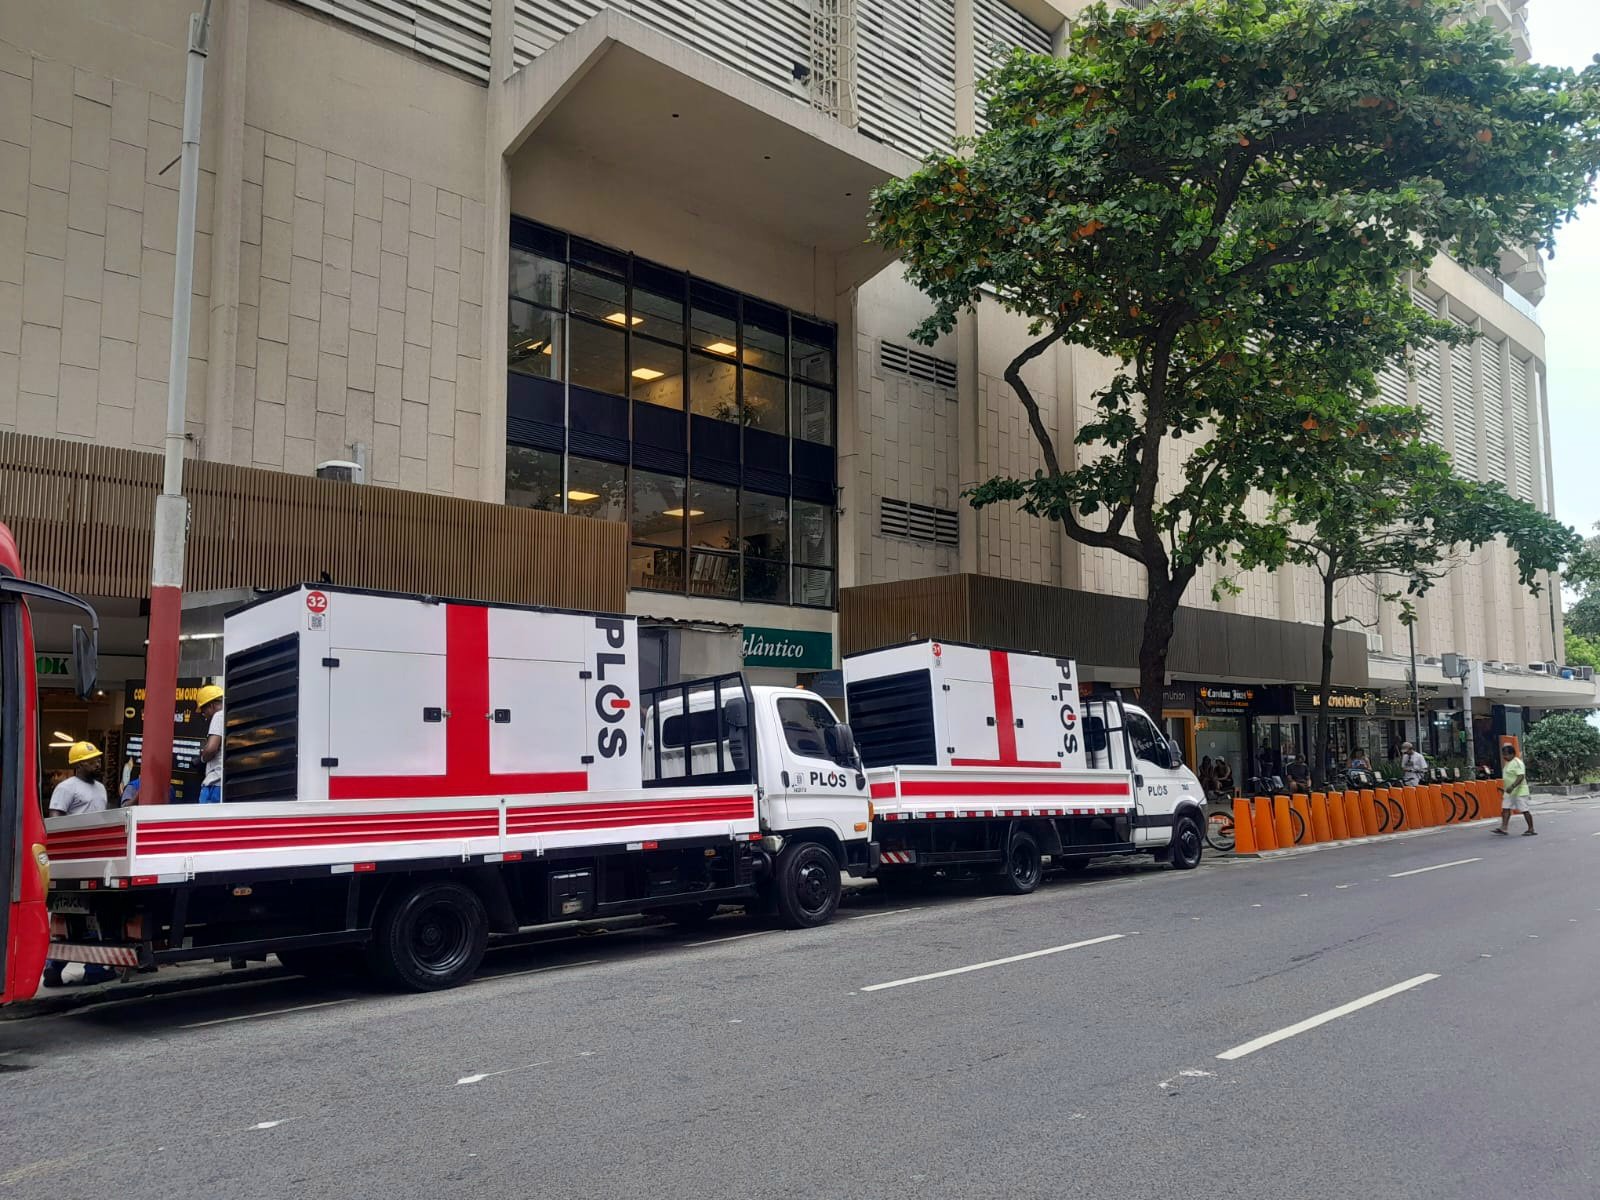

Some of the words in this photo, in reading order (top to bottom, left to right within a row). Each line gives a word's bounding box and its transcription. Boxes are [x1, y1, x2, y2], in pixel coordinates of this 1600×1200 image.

[308, 596, 326, 608] 32
[742, 633, 804, 658] tlântico
[595, 618, 631, 759] PLOS
[1056, 660, 1078, 754] PLOS
[809, 771, 847, 788] PLOS
[1147, 783, 1168, 797] PLOS
